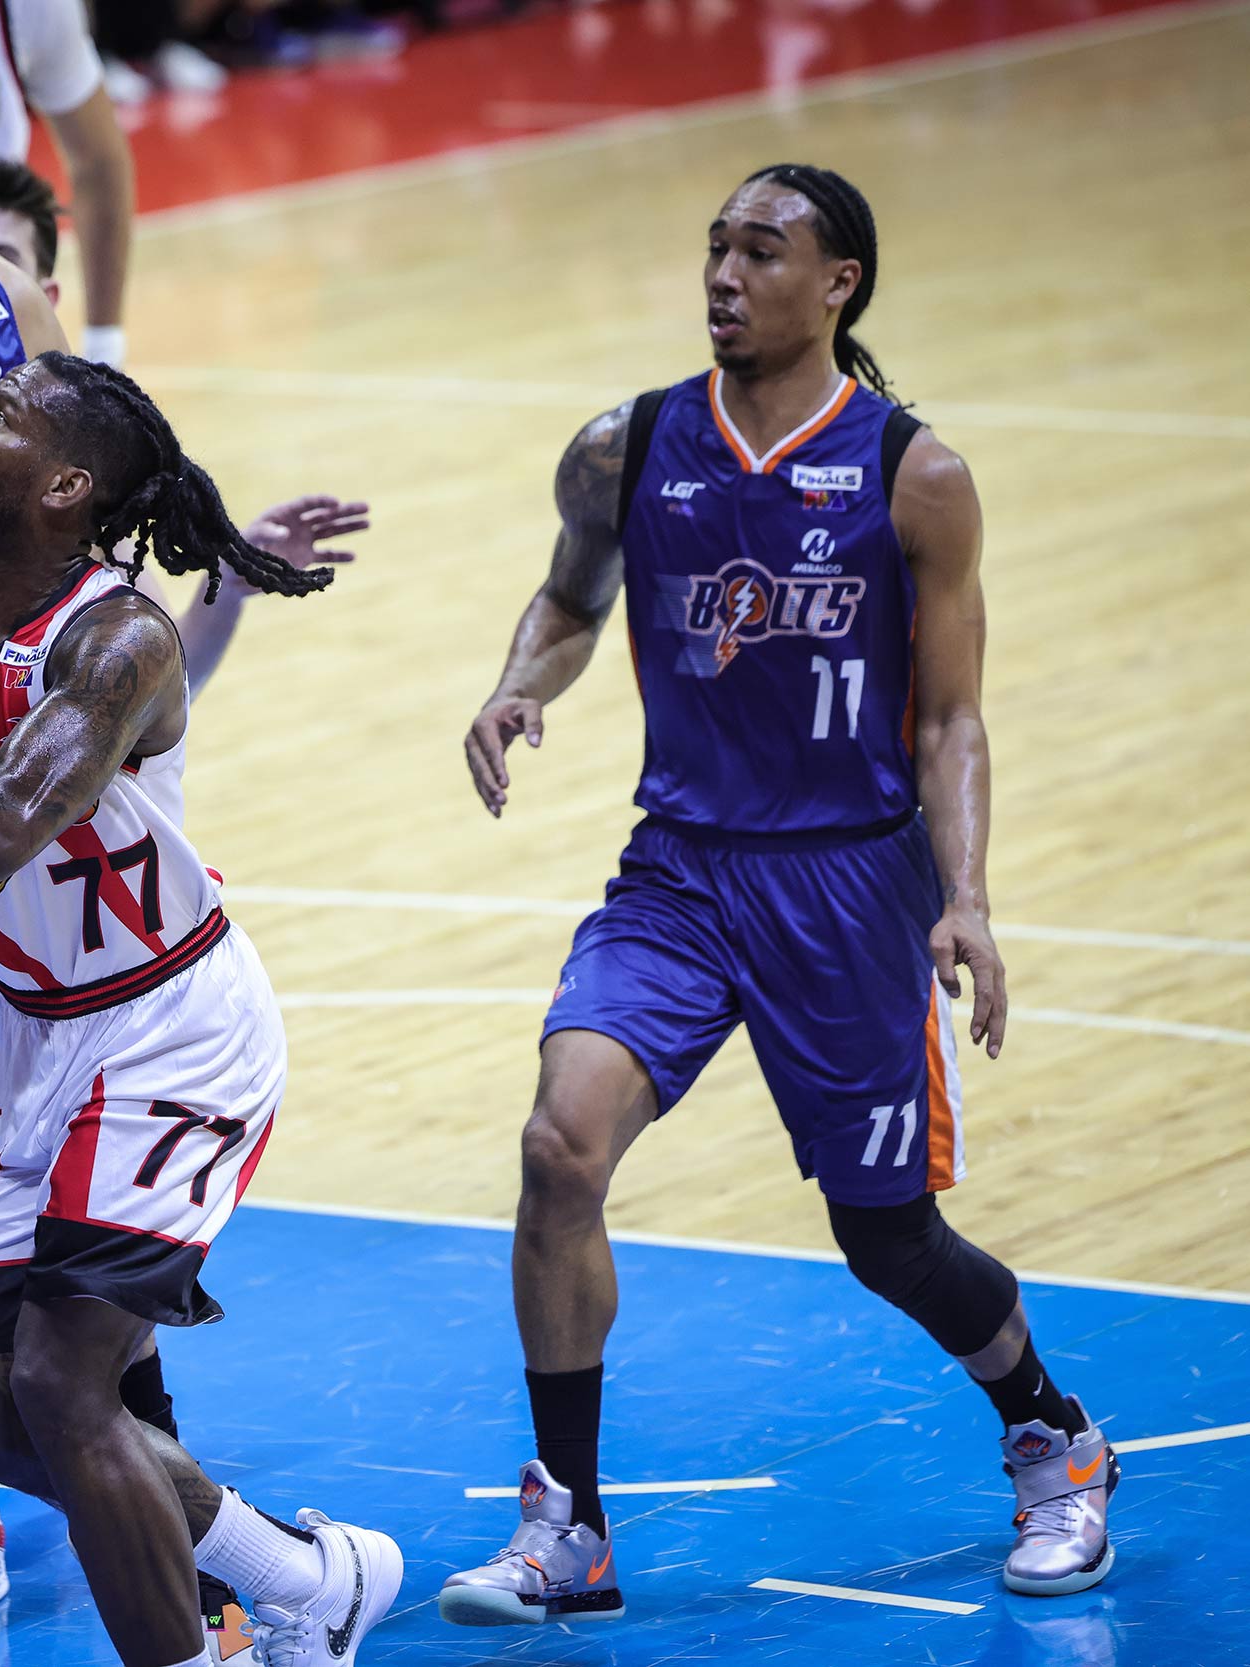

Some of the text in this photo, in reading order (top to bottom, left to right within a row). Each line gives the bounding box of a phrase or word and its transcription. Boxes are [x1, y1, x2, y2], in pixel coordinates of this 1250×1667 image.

[684, 558, 867, 643] BOLTS
[3, 645, 49, 663] FINALS
[811, 655, 866, 740] 11
[46, 829, 166, 955] 77
[131, 1099, 247, 1208] 77
[860, 1098, 918, 1168] 11
